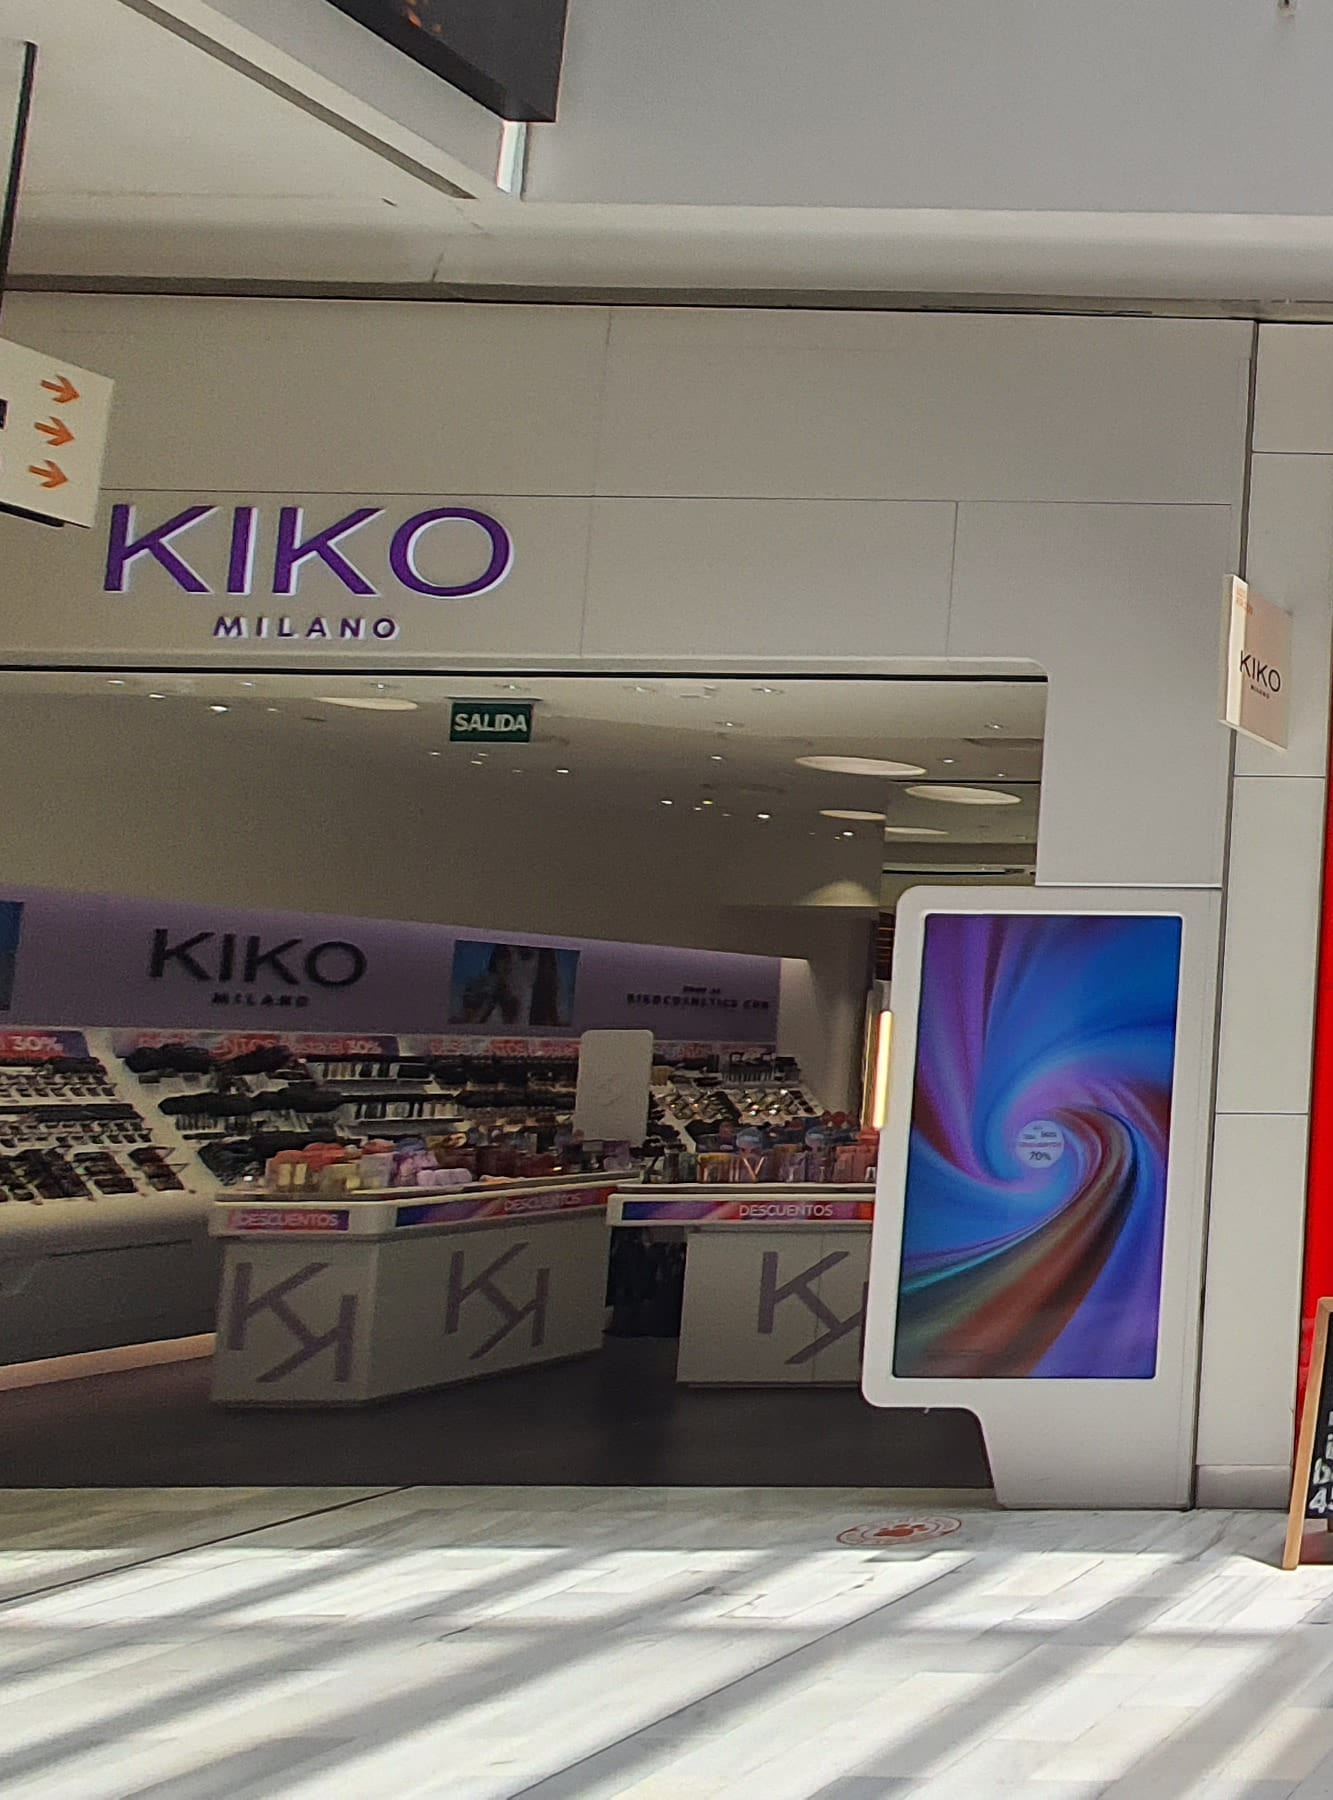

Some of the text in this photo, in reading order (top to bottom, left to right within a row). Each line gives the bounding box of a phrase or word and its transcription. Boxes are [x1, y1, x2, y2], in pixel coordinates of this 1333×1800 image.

[104, 503, 515, 599] KIKO
[213, 615, 400, 641] MILANO
[1239, 650, 1281, 693] KIKO
[453, 713, 528, 732] SALIDA
[149, 928, 368, 988] KIKO
[740, 1204, 833, 1217] DESCUENTOS
